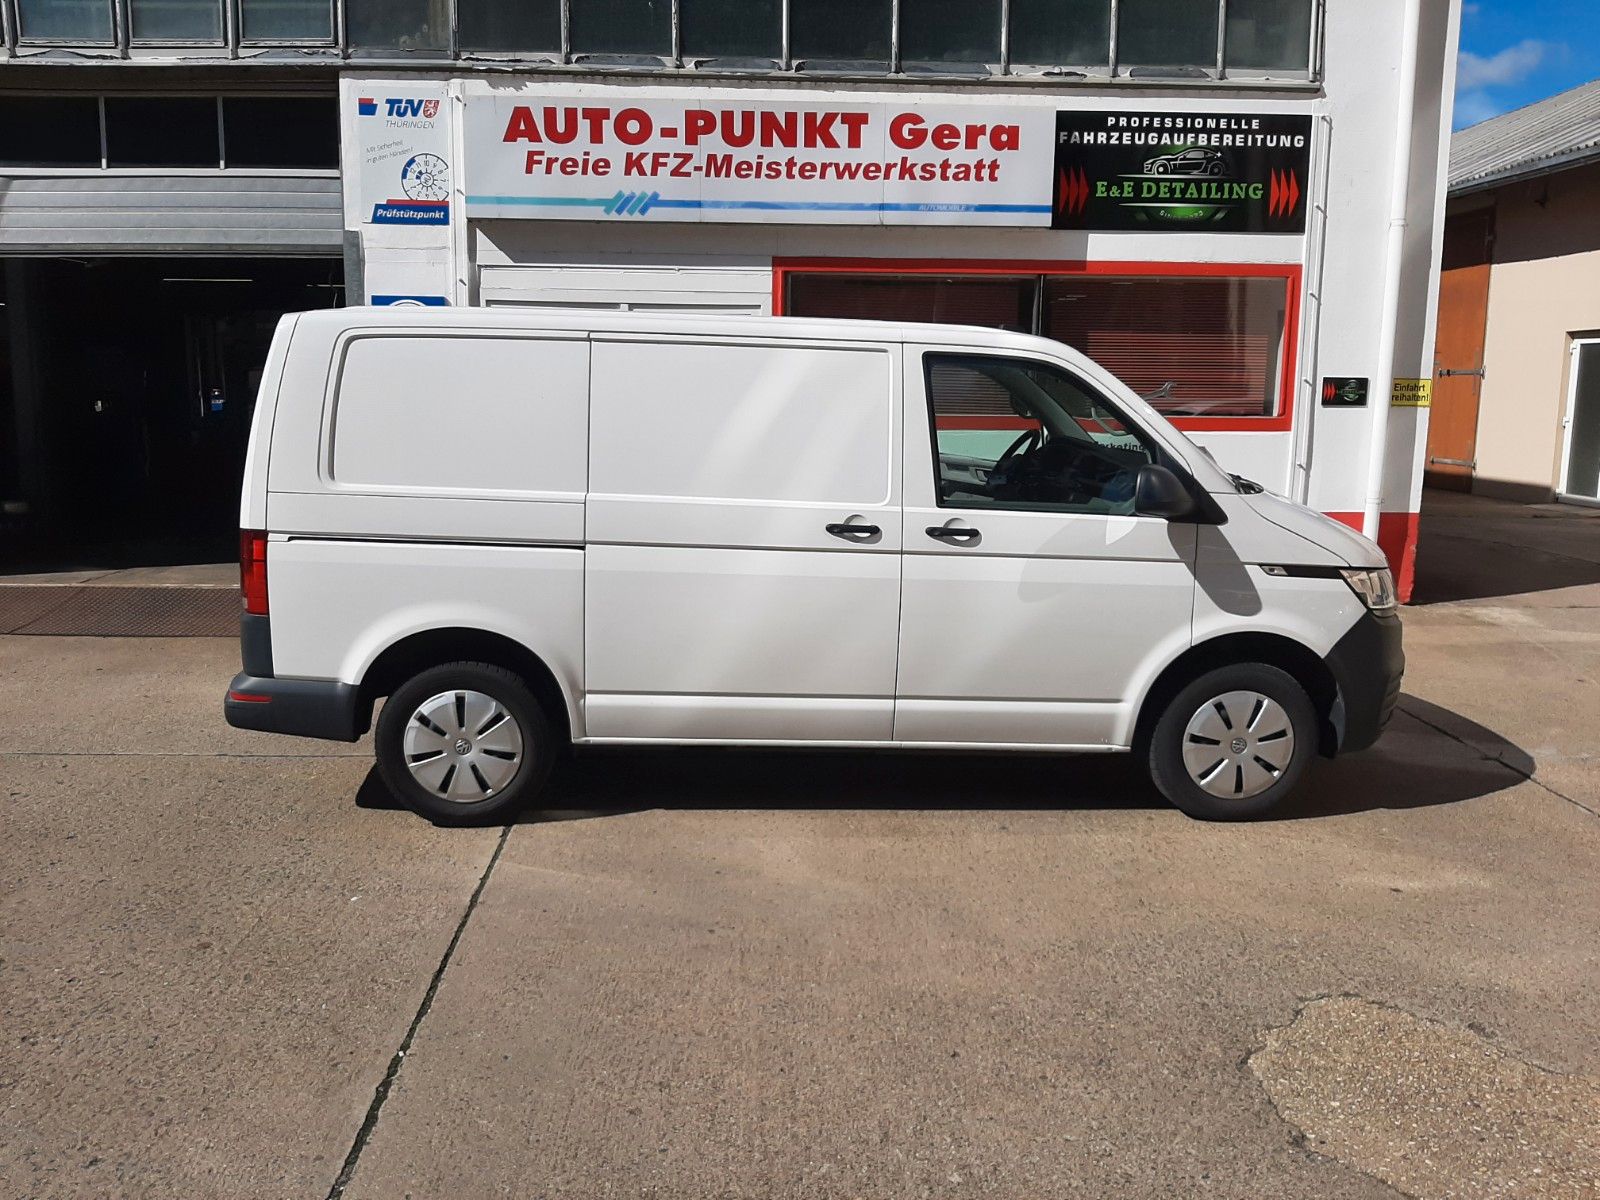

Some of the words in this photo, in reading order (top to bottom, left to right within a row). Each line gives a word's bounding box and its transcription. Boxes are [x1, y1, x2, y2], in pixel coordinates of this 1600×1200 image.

[502, 105, 869, 149] AUTO-PUNKT
[889, 112, 1020, 151] Gera
[1107, 117, 1260, 129] PROFESSIONELLE
[1059, 131, 1305, 147] FAHRZEUGAUFBEREITUNG
[524, 150, 612, 176] Freie
[623, 151, 1000, 183] KFZ-Meisterwerkstatt
[1095, 181, 1134, 198] E&E
[1141, 182, 1264, 199] DETAILING
[376, 207, 444, 220] Prüfstützpunkt
[1393, 382, 1425, 392] Einfahrt
[1391, 393, 1429, 402] reihalten!
